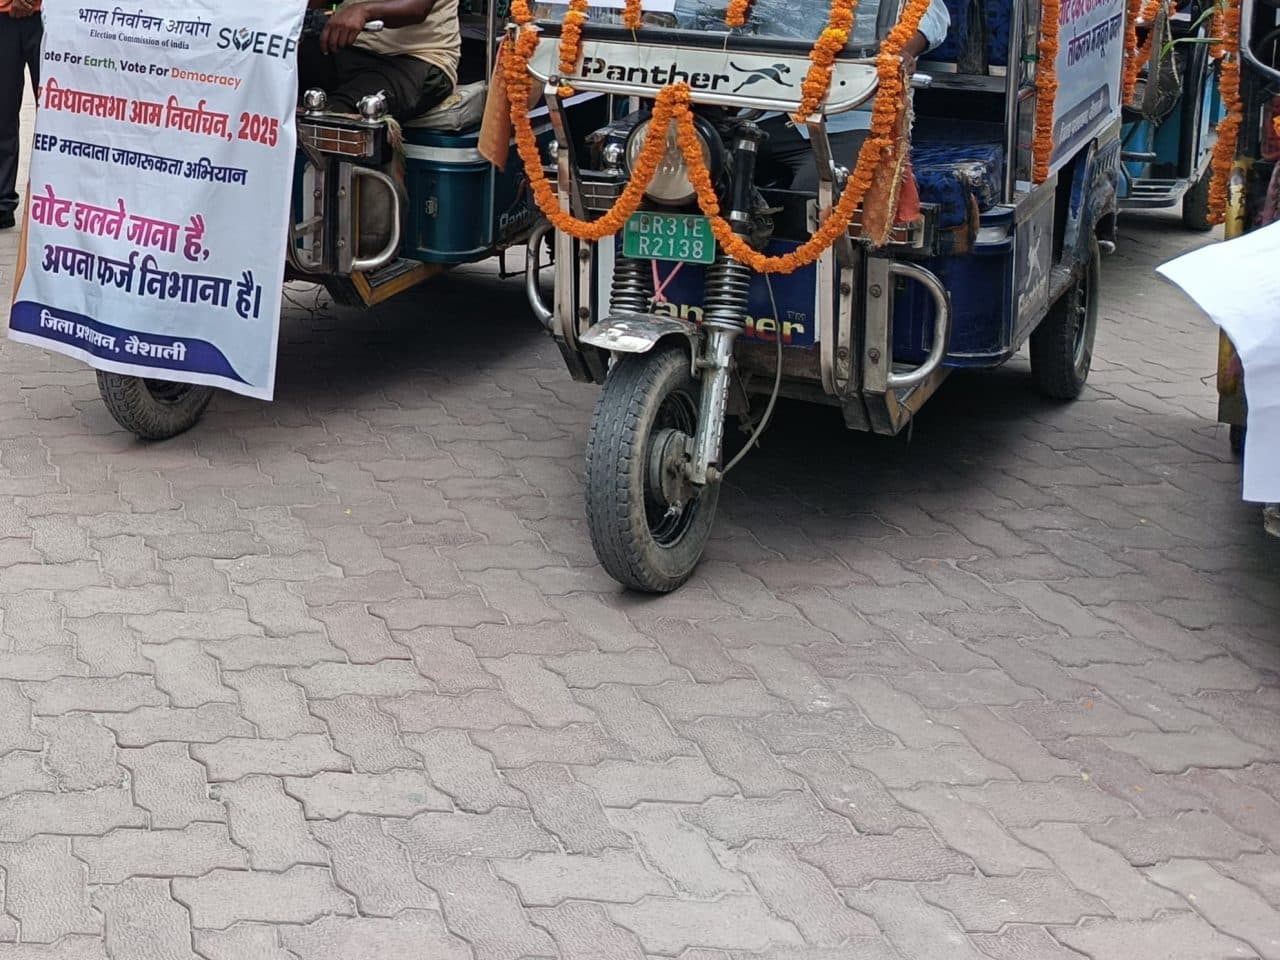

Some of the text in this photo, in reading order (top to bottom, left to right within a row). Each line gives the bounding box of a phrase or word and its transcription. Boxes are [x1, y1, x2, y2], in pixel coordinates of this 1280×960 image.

[78, 7, 212, 38] भारत निर्वाचन आयोग
[89, 29, 117, 42] Election
[118, 33, 160, 48] Commission
[161, 39, 170, 48] of
[216, 27, 297, 59] SWEEP
[44, 50, 242, 90] ote For Earth, Vote For Democracy
[581, 57, 730, 90] Panther
[45, 77, 128, 122] विधानसभा
[129, 100, 164, 129] आम
[165, 95, 233, 141] निर्वाचन,
[238, 111, 279, 147] 2025
[34, 133, 248, 185] EEP मतदाता जागरूकता अभियान
[31, 184, 210, 262] वोट डालने जाना है,
[639, 214, 704, 238] BR31E
[638, 237, 704, 259] R2138
[41, 244, 262, 319] अपना फर्ज निभाना है।
[39, 309, 187, 361] जिला प्रशासन, वैशाली
[655, 301, 805, 344] aner
